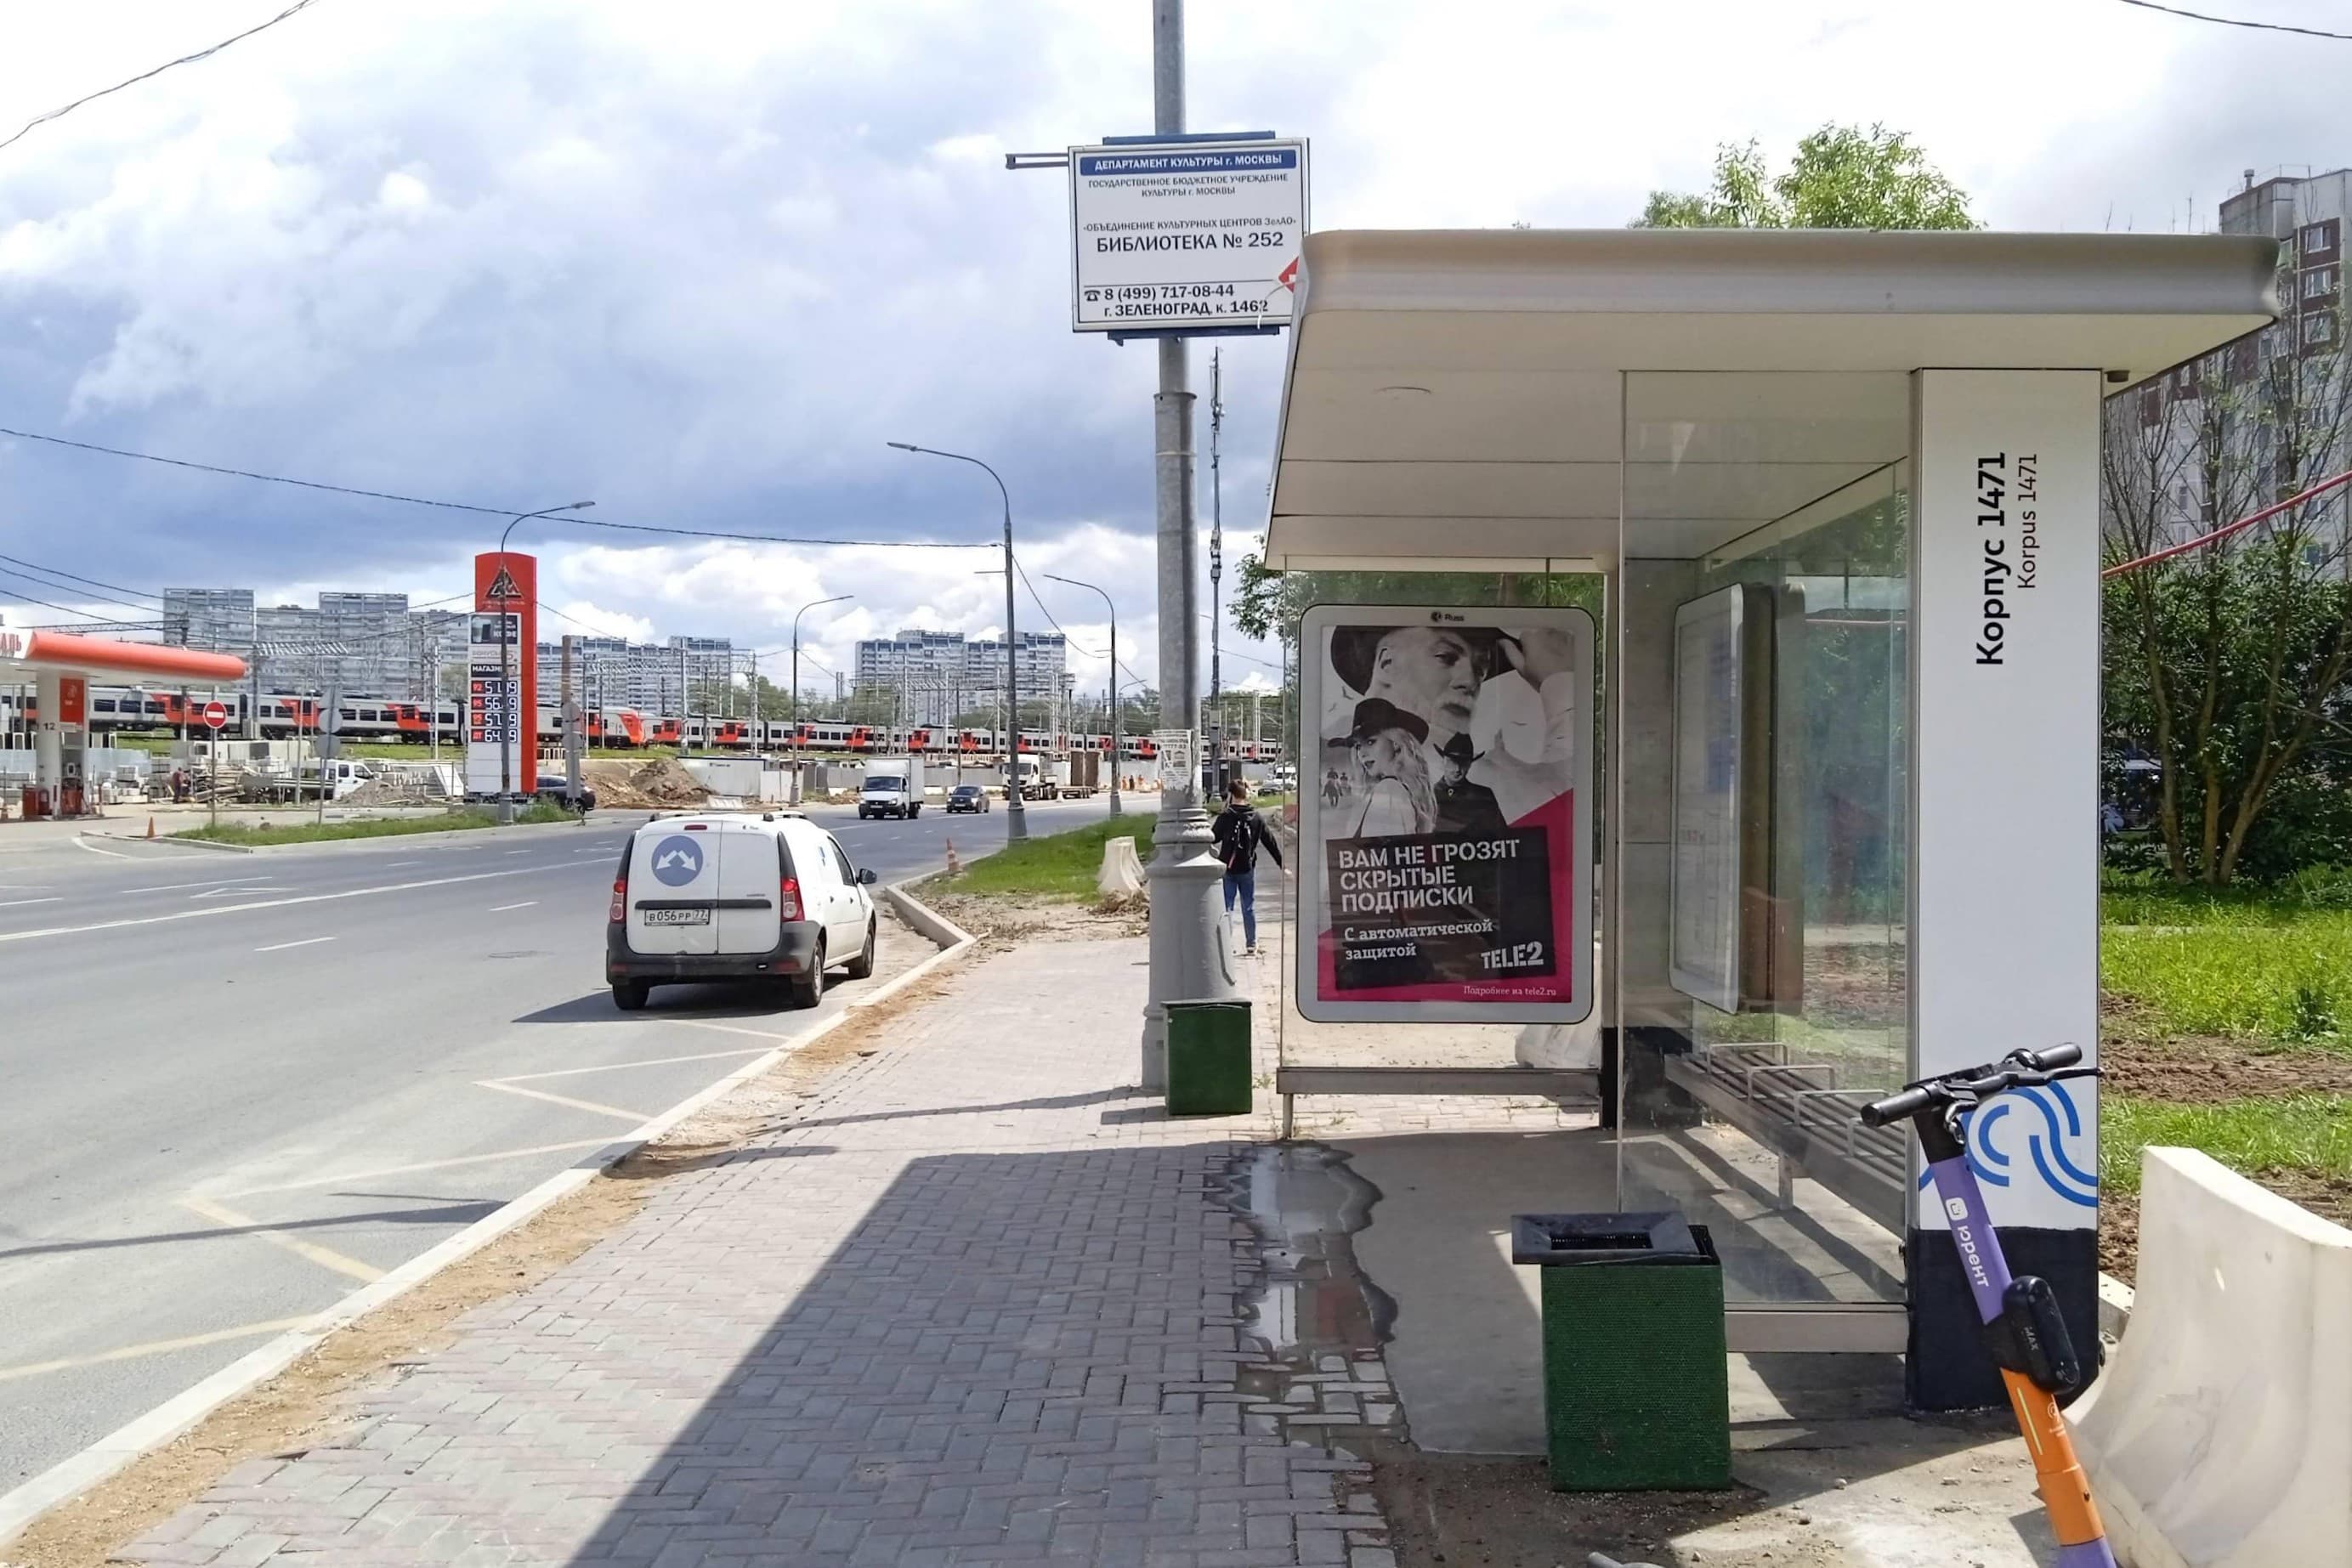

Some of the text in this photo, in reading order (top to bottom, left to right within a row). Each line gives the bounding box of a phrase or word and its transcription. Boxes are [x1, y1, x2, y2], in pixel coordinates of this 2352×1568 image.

[1095, 154, 1282, 171] ДЕПАРТАМЕНТ КУЛЬТУРЫ г. МОСКВЫ
[1089, 173, 1288, 189] ГОСУДАРСТВЕННОЕ БЮДЖЕТНОЕ УЧРЕЖДЕНИЕ
[1142, 188, 1186, 197] КУЛЬТУРЫ
[1196, 186, 1235, 195] МОСКВЫ
[1157, 218, 1217, 230] КУЛЬТУРНЫХ
[1220, 218, 1262, 228] ЦЕНТРОВ
[1097, 231, 1284, 252] БИБЛИОТЕКА № 252
[1104, 284, 1234, 303] 8 (499) 717-08-44
[1104, 308, 1112, 317] г.
[1216, 304, 1227, 314] к.
[1230, 300, 1268, 313] 1462
[2017, 454, 2040, 588] Korpus 1471
[1976, 452, 2011, 665] Корпус 1471
[1339, 839, 1521, 869] ВАМ НЕ ГРОЗЯТ
[1340, 864, 1456, 891] СКРЫТЫЕ
[1341, 886, 1474, 914] ПОДПИСКИ
[1344, 919, 1493, 942] С автоматической
[1346, 942, 1417, 961] защитой
[1481, 941, 1544, 970] TELE2
[1464, 985, 1510, 997] Подробнее
[1525, 987, 1557, 997] tele2.ru
